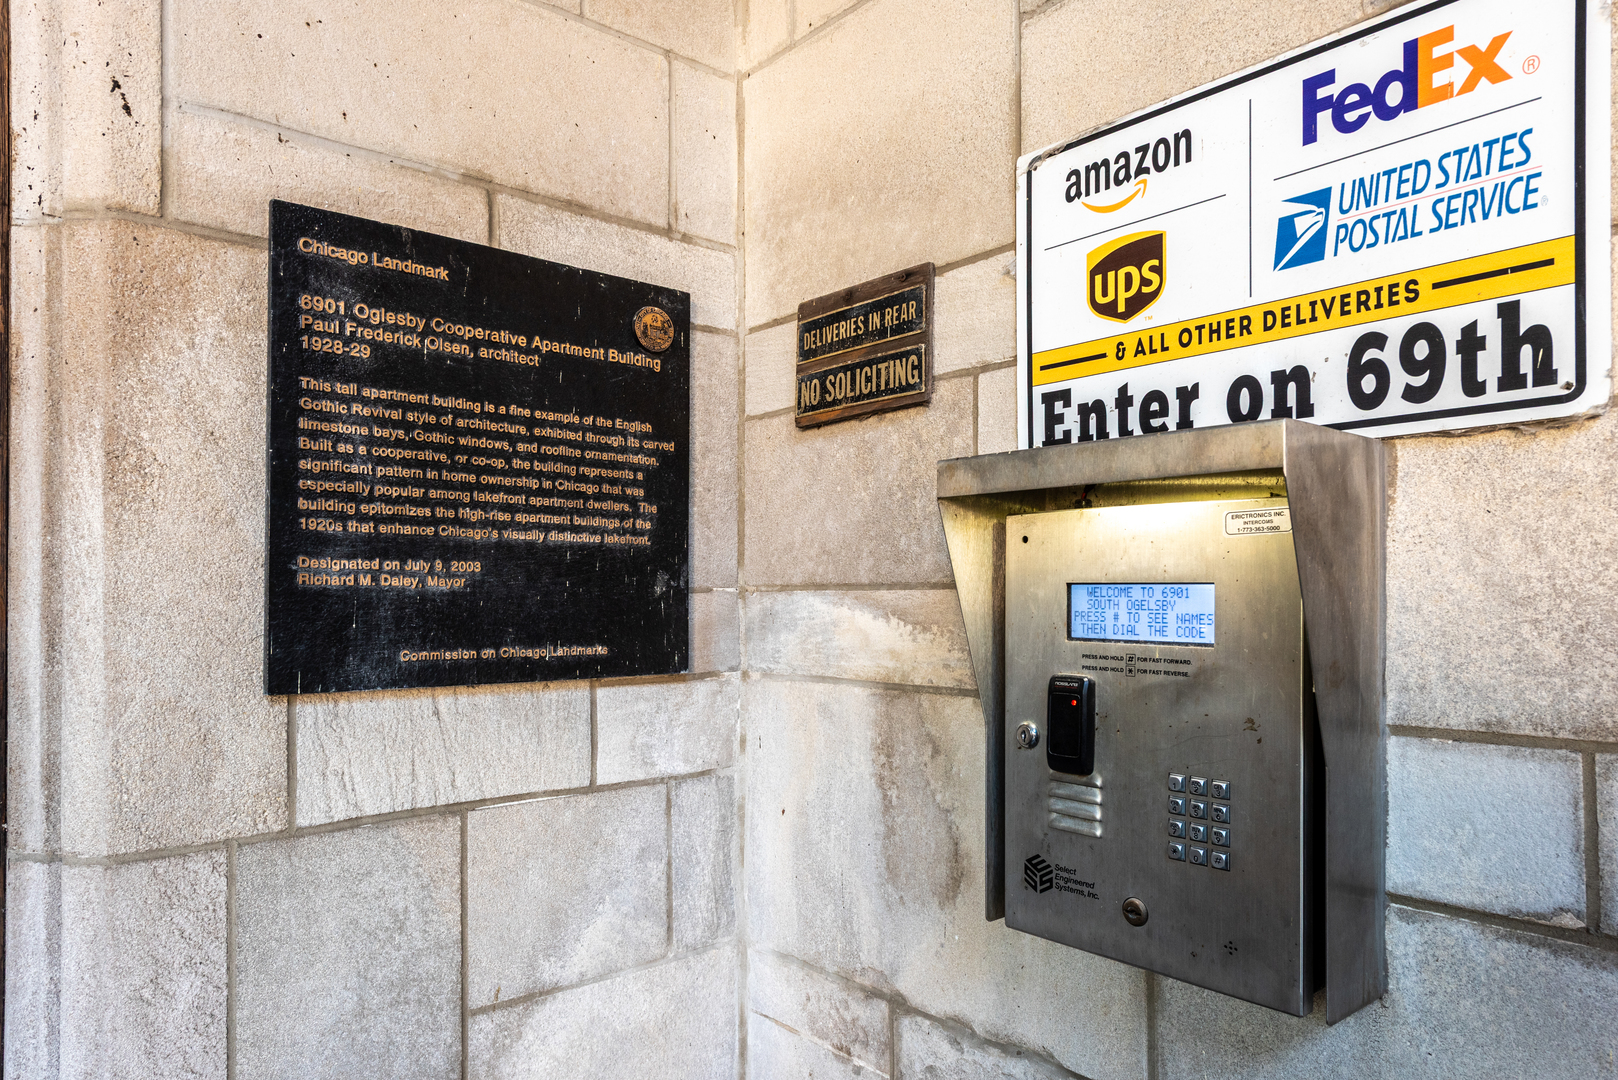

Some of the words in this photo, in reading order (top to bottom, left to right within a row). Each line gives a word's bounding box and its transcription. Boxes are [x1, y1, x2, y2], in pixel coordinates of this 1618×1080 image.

[1302, 24, 1513, 147] FedEx
[1065, 128, 1192, 203] amazon
[1338, 159, 1432, 215] UNITED
[1435, 127, 1533, 190] STATES
[1333, 204, 1423, 257] POSTAL
[1429, 171, 1542, 234] SERVICE
[298, 238, 368, 265] Chicago
[372, 252, 449, 281] Landmark
[1095, 259, 1160, 313] ups
[300, 295, 345, 315] 6901
[354, 303, 426, 332] Oglesby
[432, 318, 527, 347] Cooperative
[532, 336, 604, 360] Apartment
[608, 349, 661, 372] Building
[804, 316, 865, 350] DELIVERIES
[869, 311, 880, 331] IN
[885, 301, 917, 327] REAR
[1115, 341, 1126, 361] &
[1133, 332, 1169, 358] ALL
[1178, 315, 1252, 348] OTHER
[1263, 279, 1420, 333] DELIVERIES
[301, 315, 339, 334] Paul
[345, 322, 421, 348] Frederick
[427, 336, 474, 358] Olsen,
[480, 347, 539, 367] architect
[301, 335, 371, 358] 1928-29
[801, 378, 820, 409] NO
[825, 355, 919, 402] SOLICITING
[1041, 382, 1200, 447] Enter
[1226, 365, 1314, 424] on
[1346, 299, 1558, 411] 69th
[299, 376, 331, 392] This
[336, 382, 357, 396] tall
[362, 388, 429, 405] apartment
[432, 394, 481, 413] building
[484, 401, 495, 413] is
[499, 406, 506, 414] a
[510, 405, 531, 417] fine
[534, 410, 580, 424] example
[583, 415, 594, 425] of
[596, 417, 613, 428] the
[615, 418, 652, 433] English
[300, 397, 348, 414] Gothic
[351, 403, 402, 420] Revival
[407, 412, 436, 425] style
[441, 414, 453, 426] of
[456, 419, 530, 436] architecture,
[534, 427, 582, 441] exhibited
[585, 432, 625, 447] through
[627, 436, 640, 447] its
[642, 440, 675, 451] carved
[299, 418, 369, 435] limestone
[373, 425, 409, 441] bays,
[414, 430, 455, 445] Gothic
[458, 436, 513, 452] windows,
[517, 443, 538, 453] and
[541, 445, 582, 458] roofline
[585, 451, 659, 466] ornamentation.
[300, 437, 332, 452] Built
[337, 443, 354, 454] as
[359, 445, 367, 455] a
[372, 446, 451, 464] cooperative,
[455, 455, 468, 464] or
[472, 457, 508, 470] co-op,
[512, 458, 531, 470] the
[534, 462, 577, 476] building
[580, 467, 634, 479] represents
[637, 471, 643, 480] a
[299, 458, 372, 475] significant
[376, 466, 423, 479] pattern
[427, 468, 438, 480] in
[442, 470, 477, 483] home
[480, 475, 540, 490] ownership
[542, 478, 552, 489] in
[556, 480, 599, 494] Chicago
[602, 484, 622, 494] that
[624, 488, 644, 496] was
[299, 480, 370, 496] especially
[374, 486, 425, 498] popular
[429, 489, 470, 503] among
[474, 491, 526, 505] lakefront
[529, 496, 584, 508] apartment
[587, 499, 632, 512] dwellers.
[639, 502, 657, 514] The
[298, 497, 356, 515] building
[360, 502, 432, 517] epitomizes
[435, 507, 455, 518] the
[458, 507, 511, 522] high-rise
[515, 513, 571, 524] apartment
[574, 515, 620, 529] buildings
[623, 519, 634, 528] of
[636, 518, 651, 529] the
[300, 518, 343, 531] 1920s
[347, 520, 375, 533] that
[379, 523, 435, 535] enhance
[439, 525, 499, 540] Chicago's
[503, 528, 545, 542] visually
[548, 530, 601, 542] distinctive
[604, 533, 651, 545] lakefront.
[1231, 512, 1272, 520] ERICTRONICS
[298, 556, 380, 572] Designated
[384, 561, 400, 570] on
[404, 559, 431, 573] July
[435, 560, 447, 572] 9,
[451, 561, 481, 572] 2003
[298, 573, 354, 586] Richard
[358, 574, 376, 586] M.
[380, 574, 423, 589] Daley,
[427, 575, 465, 589] Mayor
[1086, 587, 1133, 598] WELCOME
[1141, 587, 1154, 598] TO
[1161, 587, 1189, 599] 6901
[1086, 599, 1120, 610] SOUTH
[1126, 599, 1176, 611] OGELSBY
[1074, 611, 1106, 622] PRESS
[1113, 612, 1120, 622] #
[1127, 612, 1140, 624] TO
[1147, 612, 1168, 624] SEE
[1176, 613, 1214, 626] NAMES
[1080, 623, 1106, 635] THEN
[1113, 624, 1139, 636] DIAL
[1147, 625, 1168, 637] THE
[1176, 626, 1206, 639] CODE
[400, 648, 477, 661] Commission
[481, 650, 496, 659] on
[500, 647, 546, 660] Chicago
[550, 645, 608, 657] Landmarks
[1054, 863, 1077, 875] Select
[1055, 873, 1095, 889] Engineered
[1055, 882, 1086, 898] Systems,
[1087, 890, 1100, 900] Inc.
